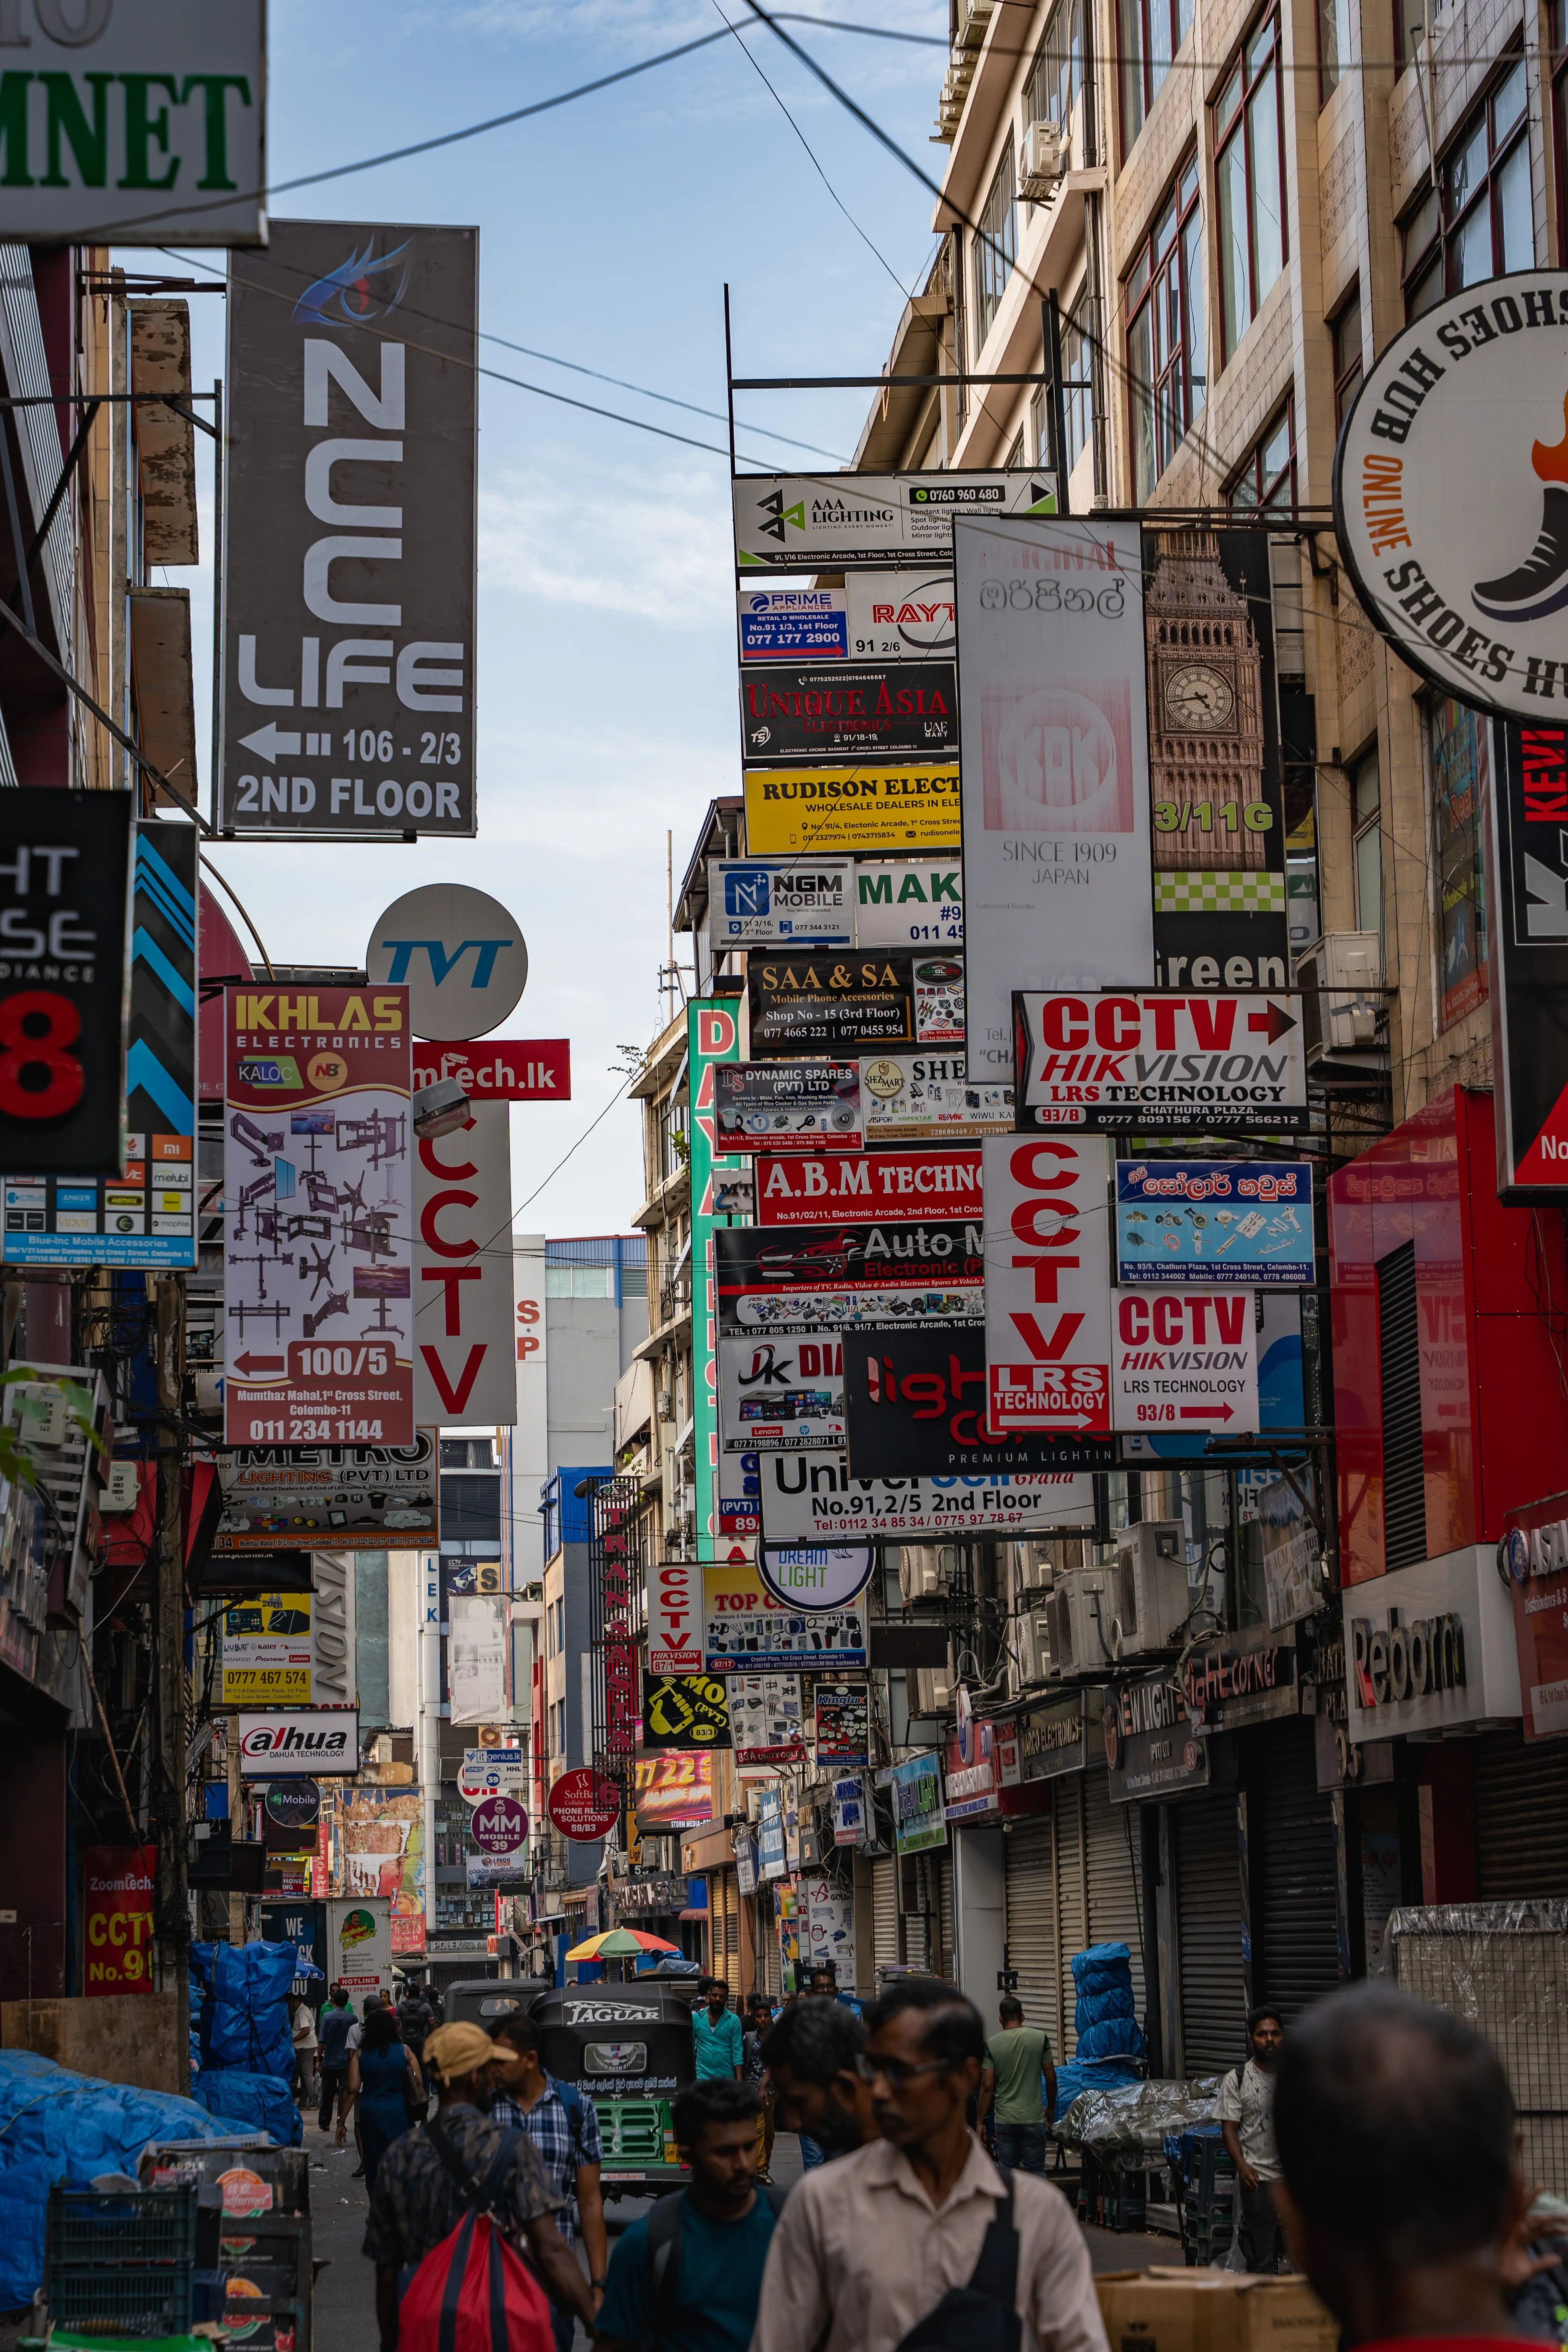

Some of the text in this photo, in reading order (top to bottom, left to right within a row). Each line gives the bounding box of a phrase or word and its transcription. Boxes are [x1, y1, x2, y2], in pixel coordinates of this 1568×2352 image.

[1369, 347, 1446, 445] HUB
[930, 489, 999, 501] 0760 960 480
[811, 498, 845, 510] AAA
[1363, 453, 1412, 557] ONLINE
[812, 510, 894, 523] LIGHTING
[771, 593, 832, 606] PRIME
[1383, 560, 1515, 683] SHOES
[747, 632, 840, 644] 077 177 2900
[238, 635, 464, 712] LIFE
[843, 733, 878, 742] 91/18-19,
[343, 729, 462, 764] 106 2/3
[237, 774, 462, 818] 2ND FLOOR
[763, 780, 878, 800] RUDISON
[806, 800, 924, 812] WHOLESALE DEALERS
[1154, 802, 1273, 832] 3/11G
[1002, 841, 1117, 863] SINCE 1909
[773, 875, 842, 892] NGM
[1033, 868, 1090, 885] JAPAN
[774, 893, 842, 907] MOBILE
[381, 940, 513, 988] TVT
[762, 964, 900, 990] SAA & SA
[771, 992, 894, 1004] Mobile Phone Accessories
[236, 995, 402, 1031] IKHLAS
[766, 1008, 900, 1022] Shop No 15 (3rd Floor)
[1042, 998, 1238, 1051] CCTV
[236, 1035, 401, 1049] ELECTRONICS
[0, 990, 85, 1119] 8
[238, 1065, 293, 1081] KALOC
[745, 1069, 853, 1081] DYNAMIC SPARES
[1039, 1054, 1287, 1082] HIKVISION
[773, 1081, 830, 1094] (PVT) LTD
[1050, 1086, 1286, 1102] LRS TECHNOLOGY
[1042, 1109, 1079, 1122] 93/8
[1143, 1106, 1209, 1115] CHATHURA
[764, 1160, 872, 1198] A.B.M
[58, 1218, 92, 1228] VIDVIE
[29, 1235, 168, 1248] Blue-Inc Mobile Accessories
[863, 1227, 953, 1260] Auto
[1009, 1141, 1086, 1360] CCTV
[864, 1260, 958, 1278] Electronic
[1119, 1296, 1246, 1346] CCTV
[297, 1347, 387, 1376] 100/5
[1121, 1352, 1248, 1370] HIKVISION
[998, 1367, 1104, 1392] LRS
[1123, 1380, 1246, 1394] LRS TECHNOLOGY
[994, 1392, 1105, 1410] TECHNOLOGY
[289, 1404, 351, 1416] Colombo-11
[1137, 1404, 1176, 1422] 93/8
[250, 1419, 383, 1440] 011 234 1144
[949, 1453, 1029, 1463] PREMIUM
[238, 1468, 429, 1484] LIGHTING (PVT) LTD
[812, 1492, 1042, 1518] No.91,2/5 2nd Floor
[778, 1567, 827, 1588] LIGHT
[659, 1569, 692, 1650] CCTV
[714, 1593, 758, 1612] TOP
[654, 1660, 674, 1672] 87/1
[714, 1660, 732, 1669] 87/17
[228, 1671, 306, 1684] 0777 467 574
[818, 1694, 867, 1707] Kinglux
[695, 1727, 713, 1737] 83/3
[296, 1750, 345, 1758] TECHNOLOGY
[283, 1795, 316, 1805] Mobile
[480, 1815, 520, 1832] MM
[571, 1824, 596, 1832] 59/B3
[492, 1841, 508, 1850] 39
[286, 1918, 303, 1936] WE
[434, 1941, 461, 1949] POLEK
[566, 2009, 659, 2025] JAGUAR
